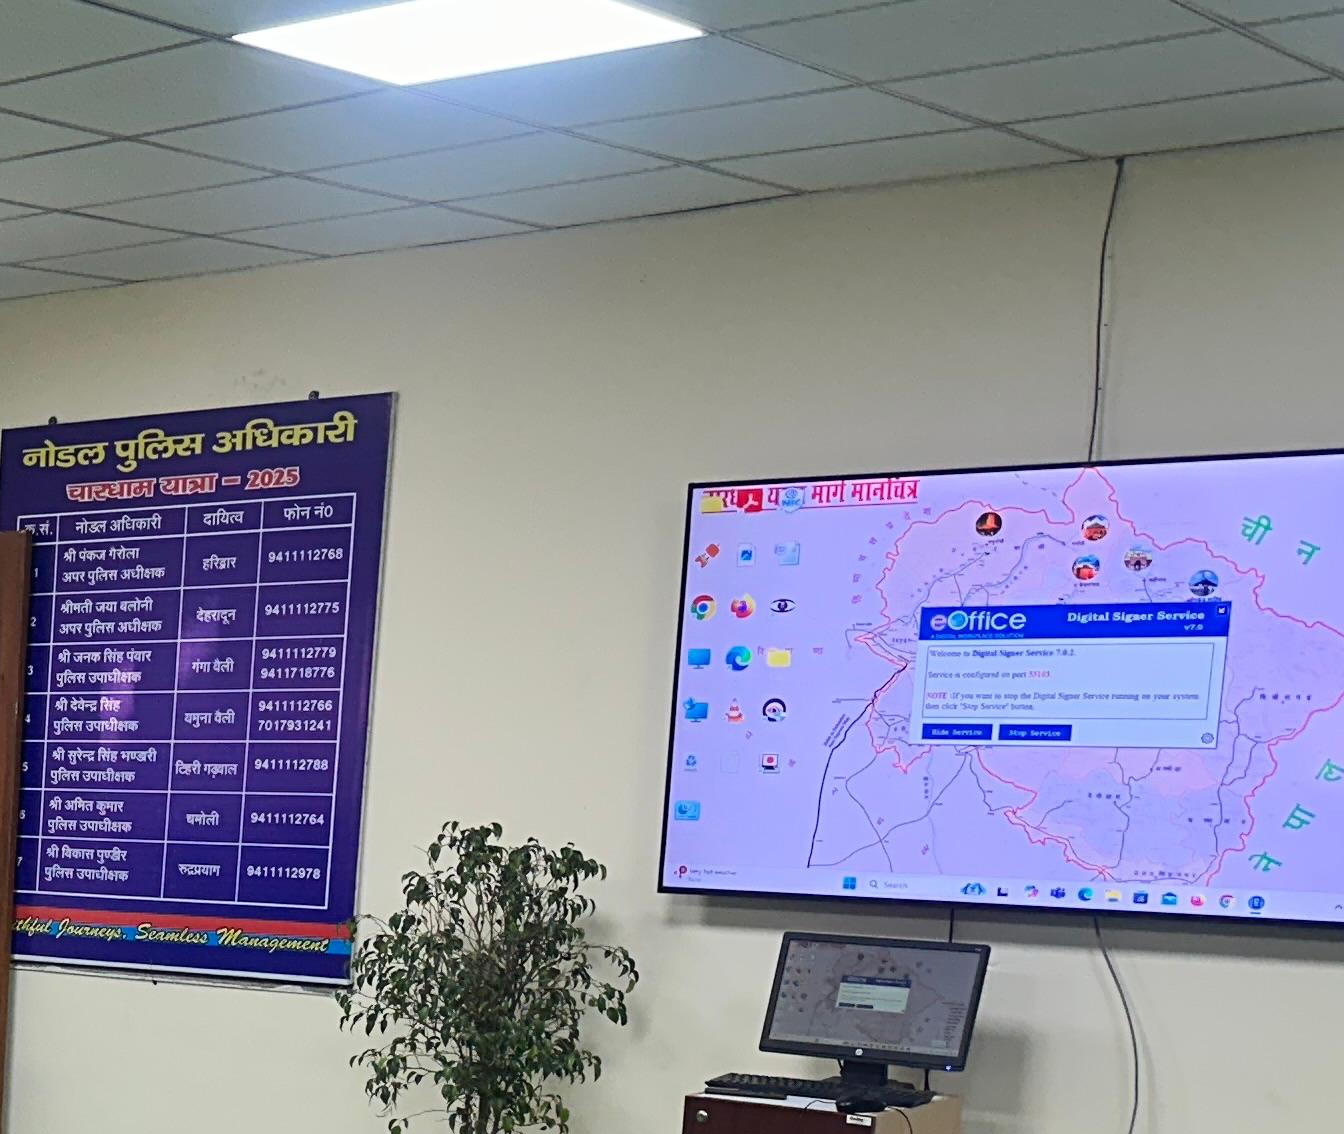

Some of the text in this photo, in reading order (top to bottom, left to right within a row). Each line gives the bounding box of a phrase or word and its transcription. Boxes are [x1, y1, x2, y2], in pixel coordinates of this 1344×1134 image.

[22, 411, 358, 473] नोडल पुलिस अधिकारी
[66, 466, 300, 502] चारधाम यात्रा 2025
[851, 477, 920, 502] मानचित्र
[203, 508, 244, 526] दायित्व
[284, 504, 311, 521] फोन
[75, 513, 162, 534] नोडल अधिकारी
[63, 548, 76, 563] श्री
[78, 547, 106, 561] पंकज
[268, 548, 343, 563] 9411112768
[34, 568, 39, 578] 1
[62, 565, 165, 585] अपर पुलिस अधीक्षक
[60, 599, 93, 614] श्रीमती
[95, 601, 117, 613] जया
[264, 602, 340, 616] 9411112775
[30, 617, 37, 627] 2
[196, 607, 236, 625] देहरादून
[930, 610, 1027, 631] eOffice
[1067, 610, 1205, 623] Digital Signer Service
[59, 617, 163, 638] अपर पुलिस अधीक्षक
[58, 649, 71, 664] श्री
[73, 651, 101, 664] जनक
[103, 648, 124, 663] सिंह
[261, 647, 337, 660] 9411112779
[27, 665, 34, 676] 3
[192, 661, 211, 674] गंगा
[56, 668, 142, 688] पुलिस उपाधीक्षक
[54, 697, 68, 712] श्री
[99, 696, 121, 712] सिंह
[258, 700, 332, 712] 9411112766
[24, 713, 31, 723] 4
[53, 717, 139, 735] पुलिस उपाधीक्षक
[184, 712, 212, 728] यमुना
[257, 719, 332, 731] 7017931241
[52, 746, 65, 762] श्री
[97, 747, 118, 762] सिंह
[22, 762, 28, 771] 5
[175, 760, 201, 776] टिहरी
[254, 758, 329, 771] 9411112788
[50, 767, 136, 785] पुलिस उपाधीक्षक
[49, 796, 62, 811] श्री
[96, 800, 124, 815] कुमार
[47, 816, 132, 833] पुलिस उपाधीक्षक
[185, 811, 219, 826] चमोली
[250, 812, 324, 826] 9411112764
[46, 844, 59, 860] श्री
[61, 844, 94, 860] विकास
[44, 863, 129, 882] पुलिस उपाधीक्षक
[246, 865, 321, 880] 9411112978
[14, 917, 52, 936] thful
[135, 922, 208, 944] Seamless
[216, 927, 329, 953] Management
